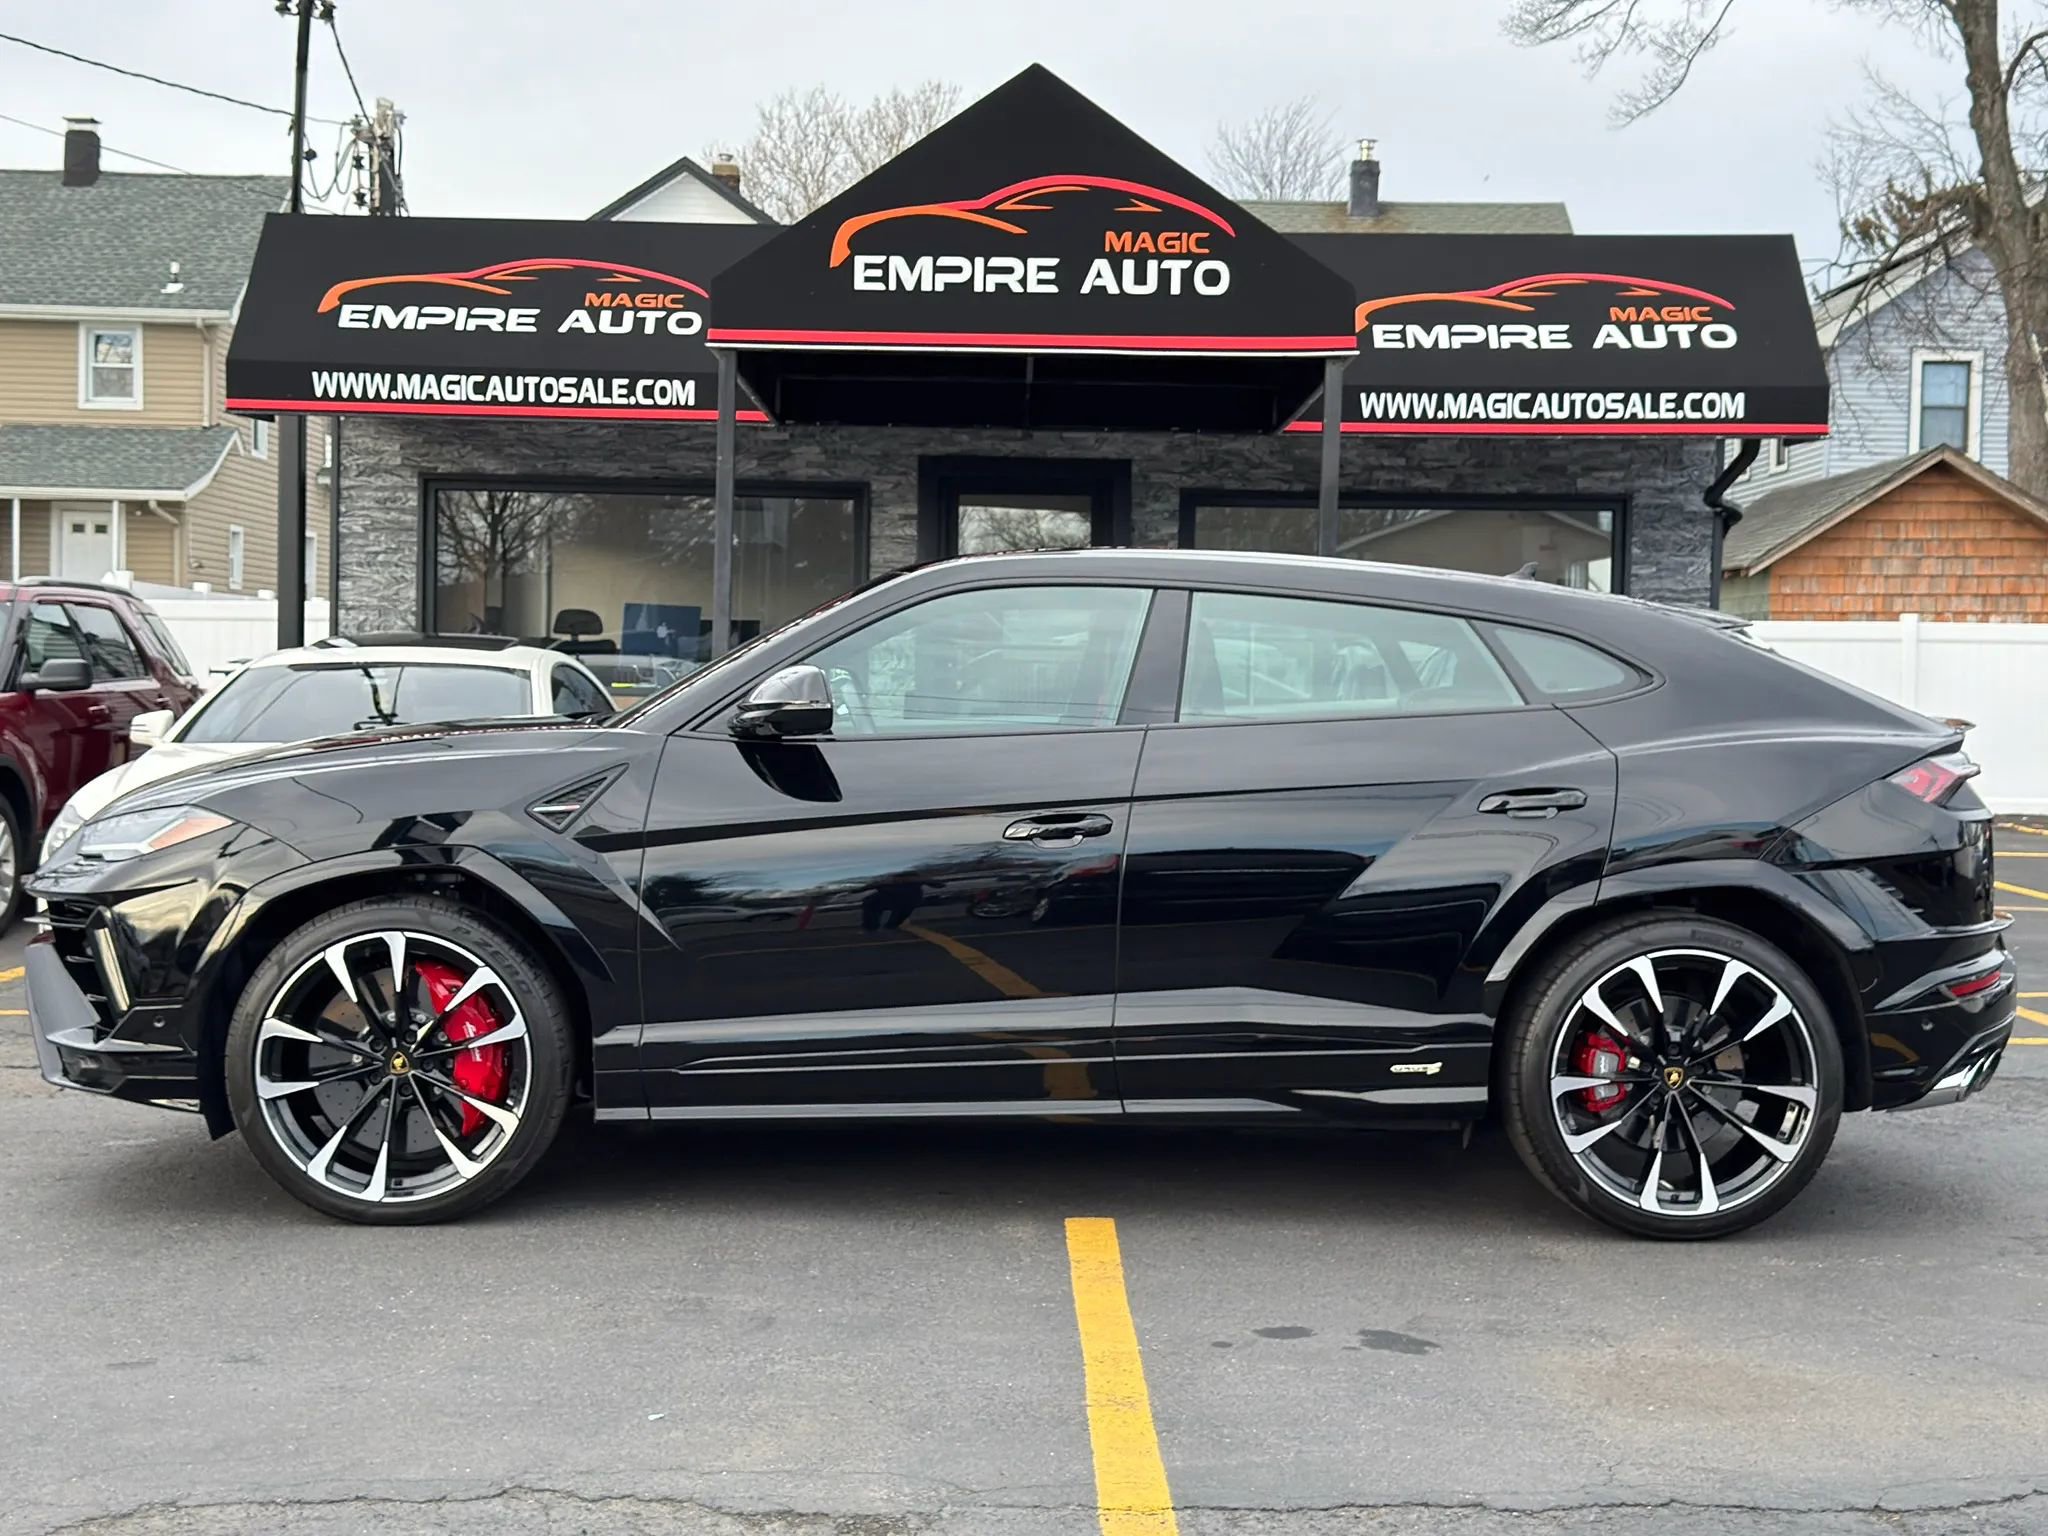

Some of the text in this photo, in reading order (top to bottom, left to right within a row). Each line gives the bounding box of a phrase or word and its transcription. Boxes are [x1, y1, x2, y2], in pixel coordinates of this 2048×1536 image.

[1105, 231, 1210, 254] MAGIC
[854, 255, 1230, 295] EMPIRE AUTO
[586, 293, 684, 308] MAGIC
[338, 305, 702, 335] EMPIRE AUTO
[1610, 306, 1712, 322] MAGIC
[1372, 324, 1737, 349] EMPIRE AUTO
[312, 371, 695, 406] WWW.MAGICAUTOSALE.COM
[1360, 392, 1745, 419] WWW.MAGICAUTOSALE.COM
